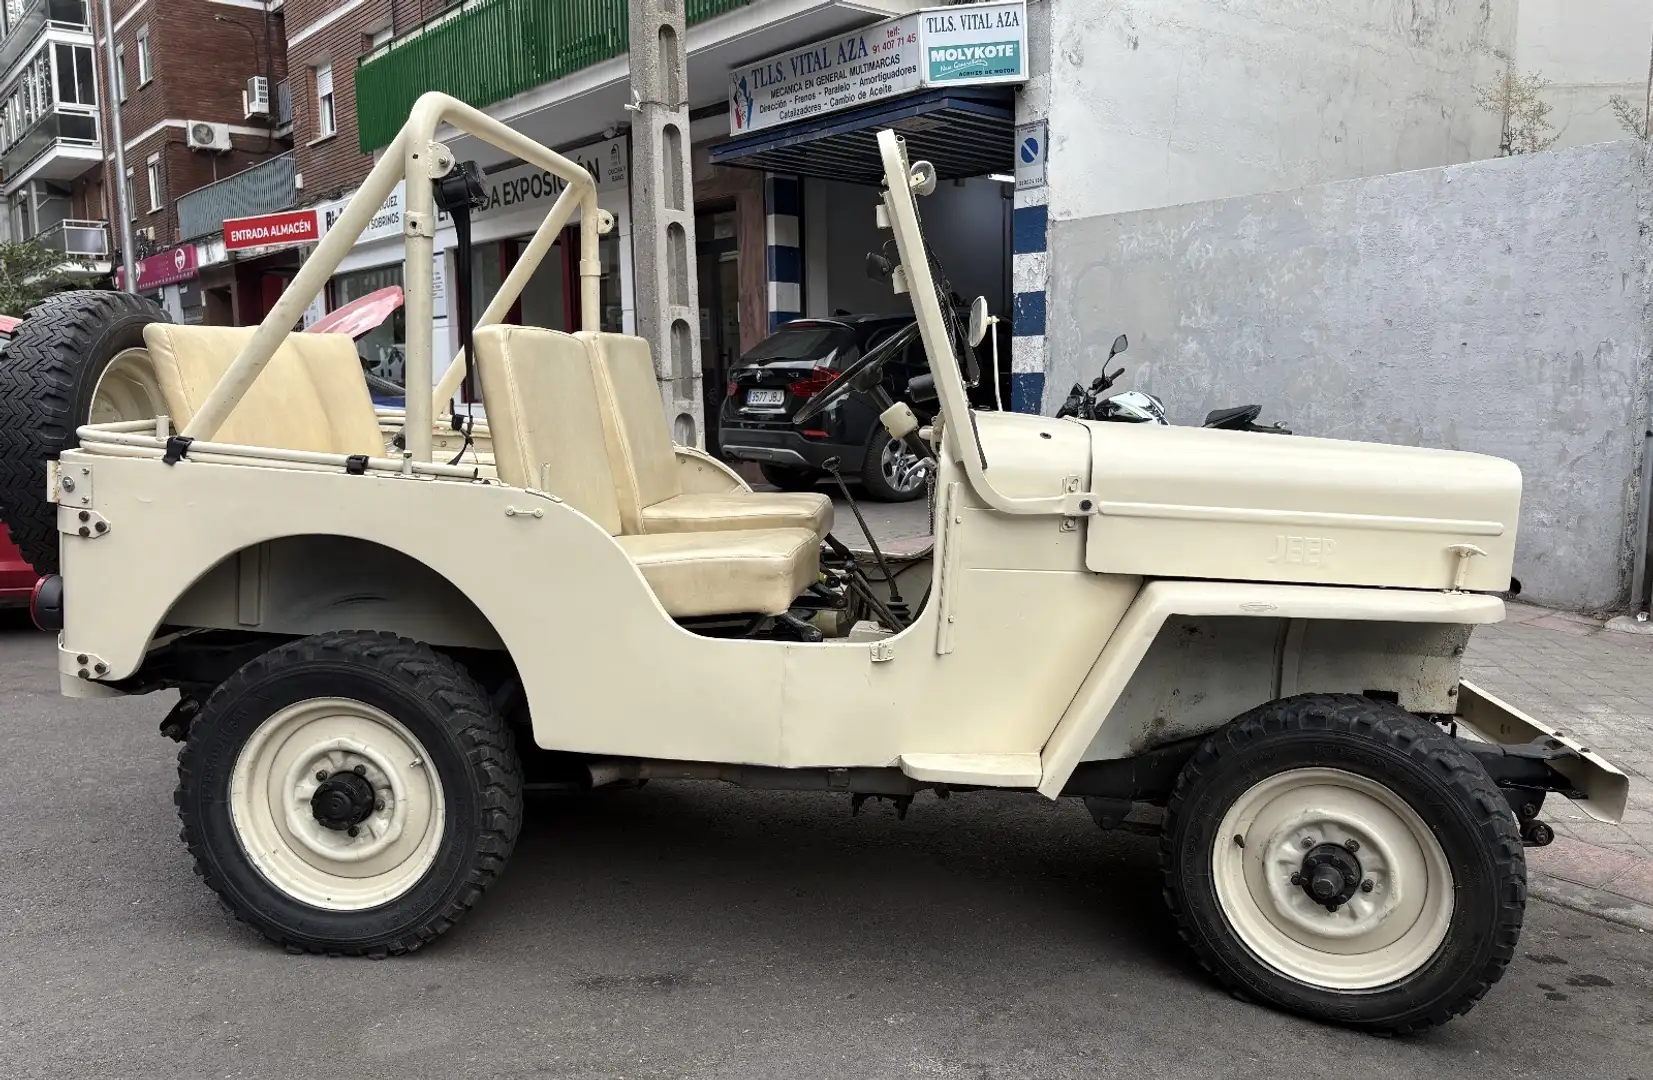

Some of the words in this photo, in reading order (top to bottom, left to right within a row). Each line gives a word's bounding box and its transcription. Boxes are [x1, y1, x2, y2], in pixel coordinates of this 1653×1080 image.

[926, 16, 957, 33] TLLS.
[960, 13, 993, 31] VITAL
[996, 11, 1020, 28] AZA
[872, 44, 881, 54] 91
[882, 40, 895, 51] 407
[897, 36, 906, 48] 71
[907, 33, 916, 44] 45
[931, 44, 1014, 62] MOLYKOTE
[752, 61, 786, 89] TLLS.
[790, 47, 832, 77] VITAL
[837, 36, 868, 65] AZA
[805, 79, 815, 90] EN
[816, 70, 847, 87] GENERAL
[849, 54, 900, 76] MULTIMARCAS
[759, 99, 788, 113] Dirección
[794, 92, 816, 104] Frenos
[824, 84, 851, 95] Paralelo
[859, 64, 917, 87] Amortiguadores
[779, 102, 822, 120] Catalizadores
[829, 94, 856, 108] Cambio
[857, 90, 867, 100] de
[868, 84, 892, 97] Aceite
[231, 227, 269, 242] ENTRADA
[270, 218, 311, 237] ALMACÉN
[370, 212, 400, 230] SOBRINOS
[752, 391, 767, 401] 3577
[1267, 535, 1338, 567] JEEP
